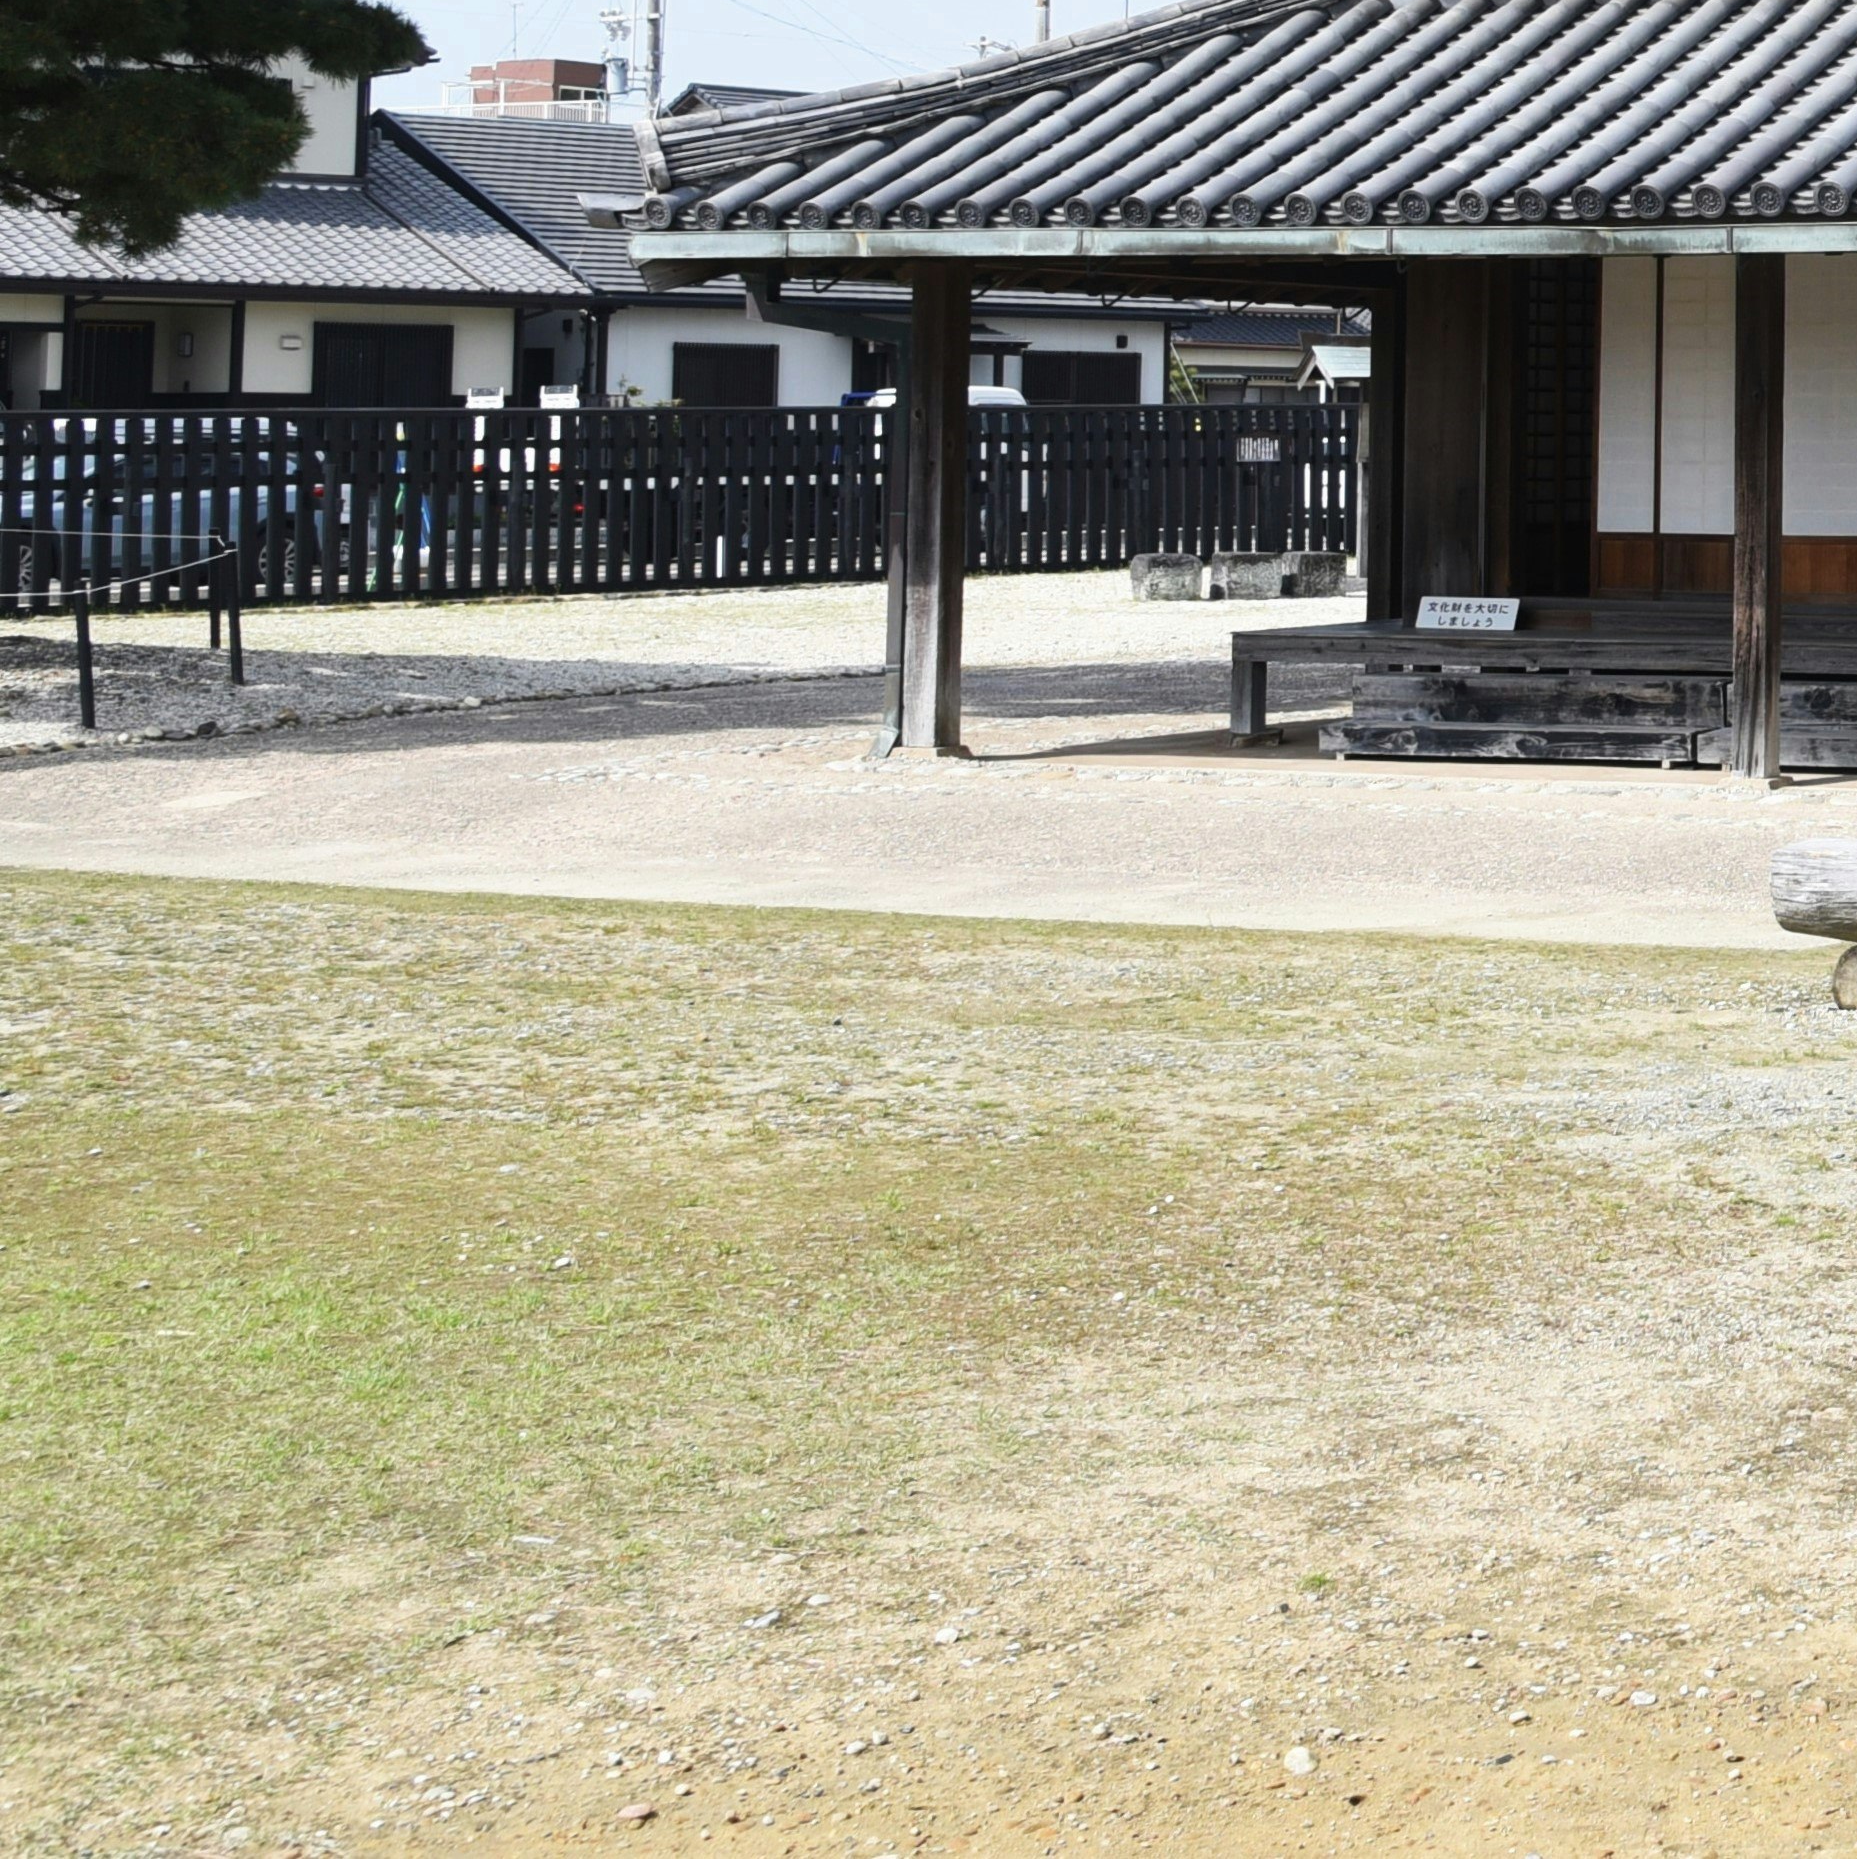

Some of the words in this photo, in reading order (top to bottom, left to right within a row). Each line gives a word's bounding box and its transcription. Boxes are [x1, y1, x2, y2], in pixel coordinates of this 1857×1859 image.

[1427, 601, 1509, 615] 文化財を大切に
[1438, 616, 1494, 628] しましょう
